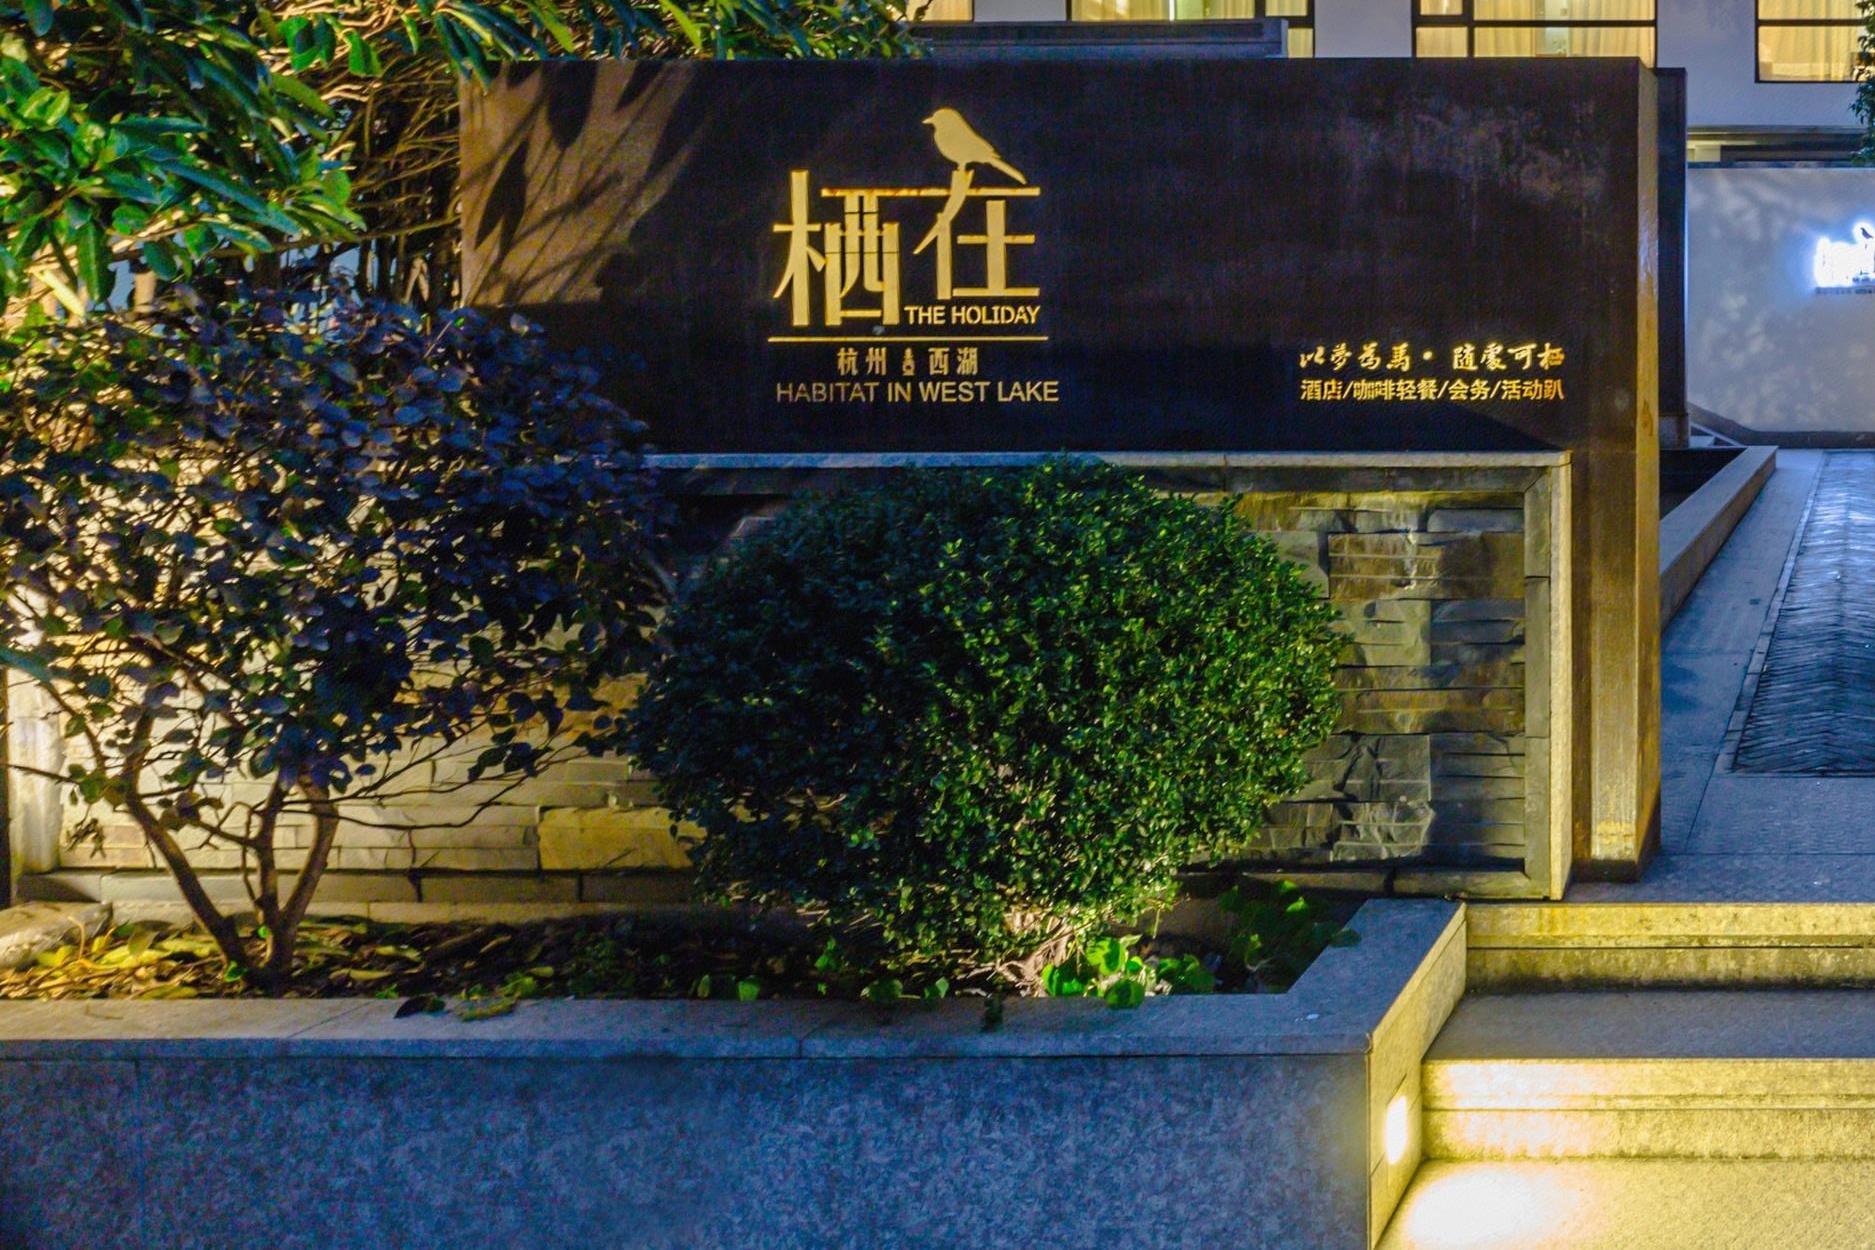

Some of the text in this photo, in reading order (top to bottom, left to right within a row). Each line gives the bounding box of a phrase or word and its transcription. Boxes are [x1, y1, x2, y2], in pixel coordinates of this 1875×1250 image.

[904, 305, 1041, 325] THE HOLIDAY
[837, 346, 978, 376] 杭州 西湖
[776, 381, 1060, 403] HABITAT IN WEST LAKE
